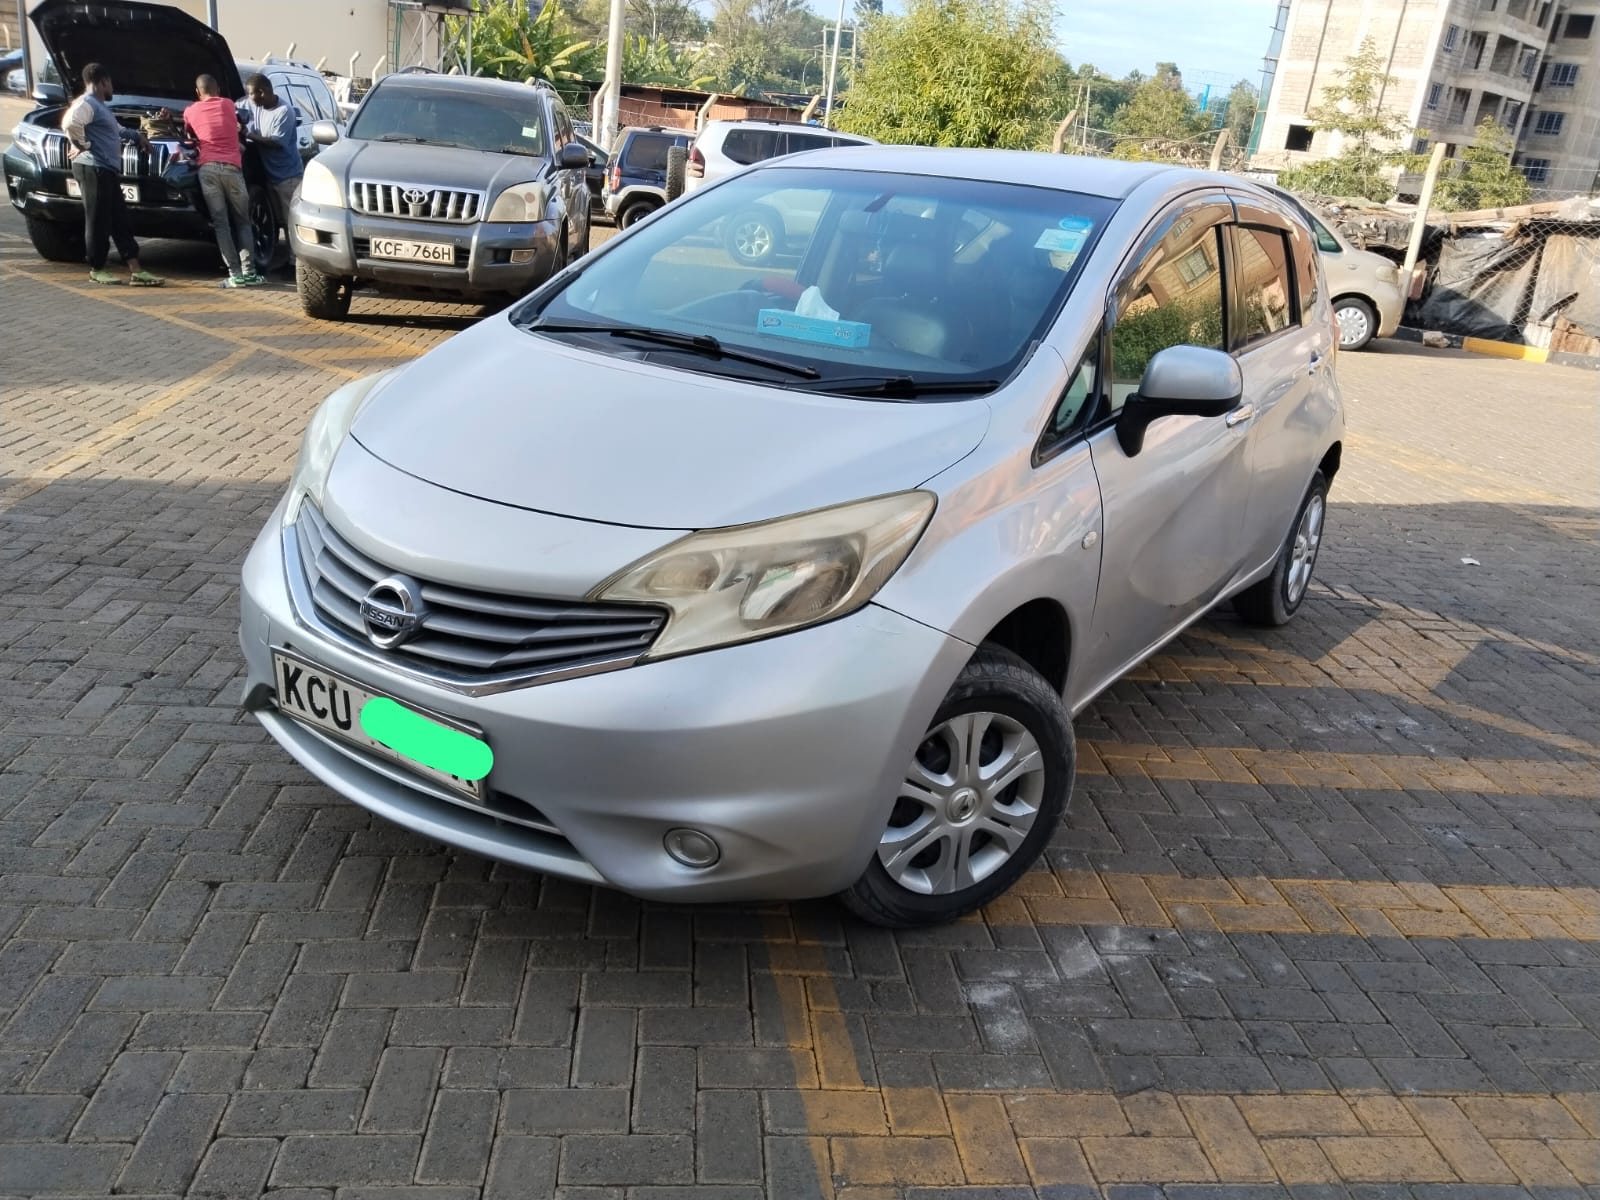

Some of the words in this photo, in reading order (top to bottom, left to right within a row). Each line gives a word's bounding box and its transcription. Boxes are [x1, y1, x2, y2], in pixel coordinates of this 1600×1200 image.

[373, 240, 403, 256] KCF
[412, 244, 451, 261] 766H
[361, 602, 405, 628] NISSAN
[282, 662, 352, 730] KCU
